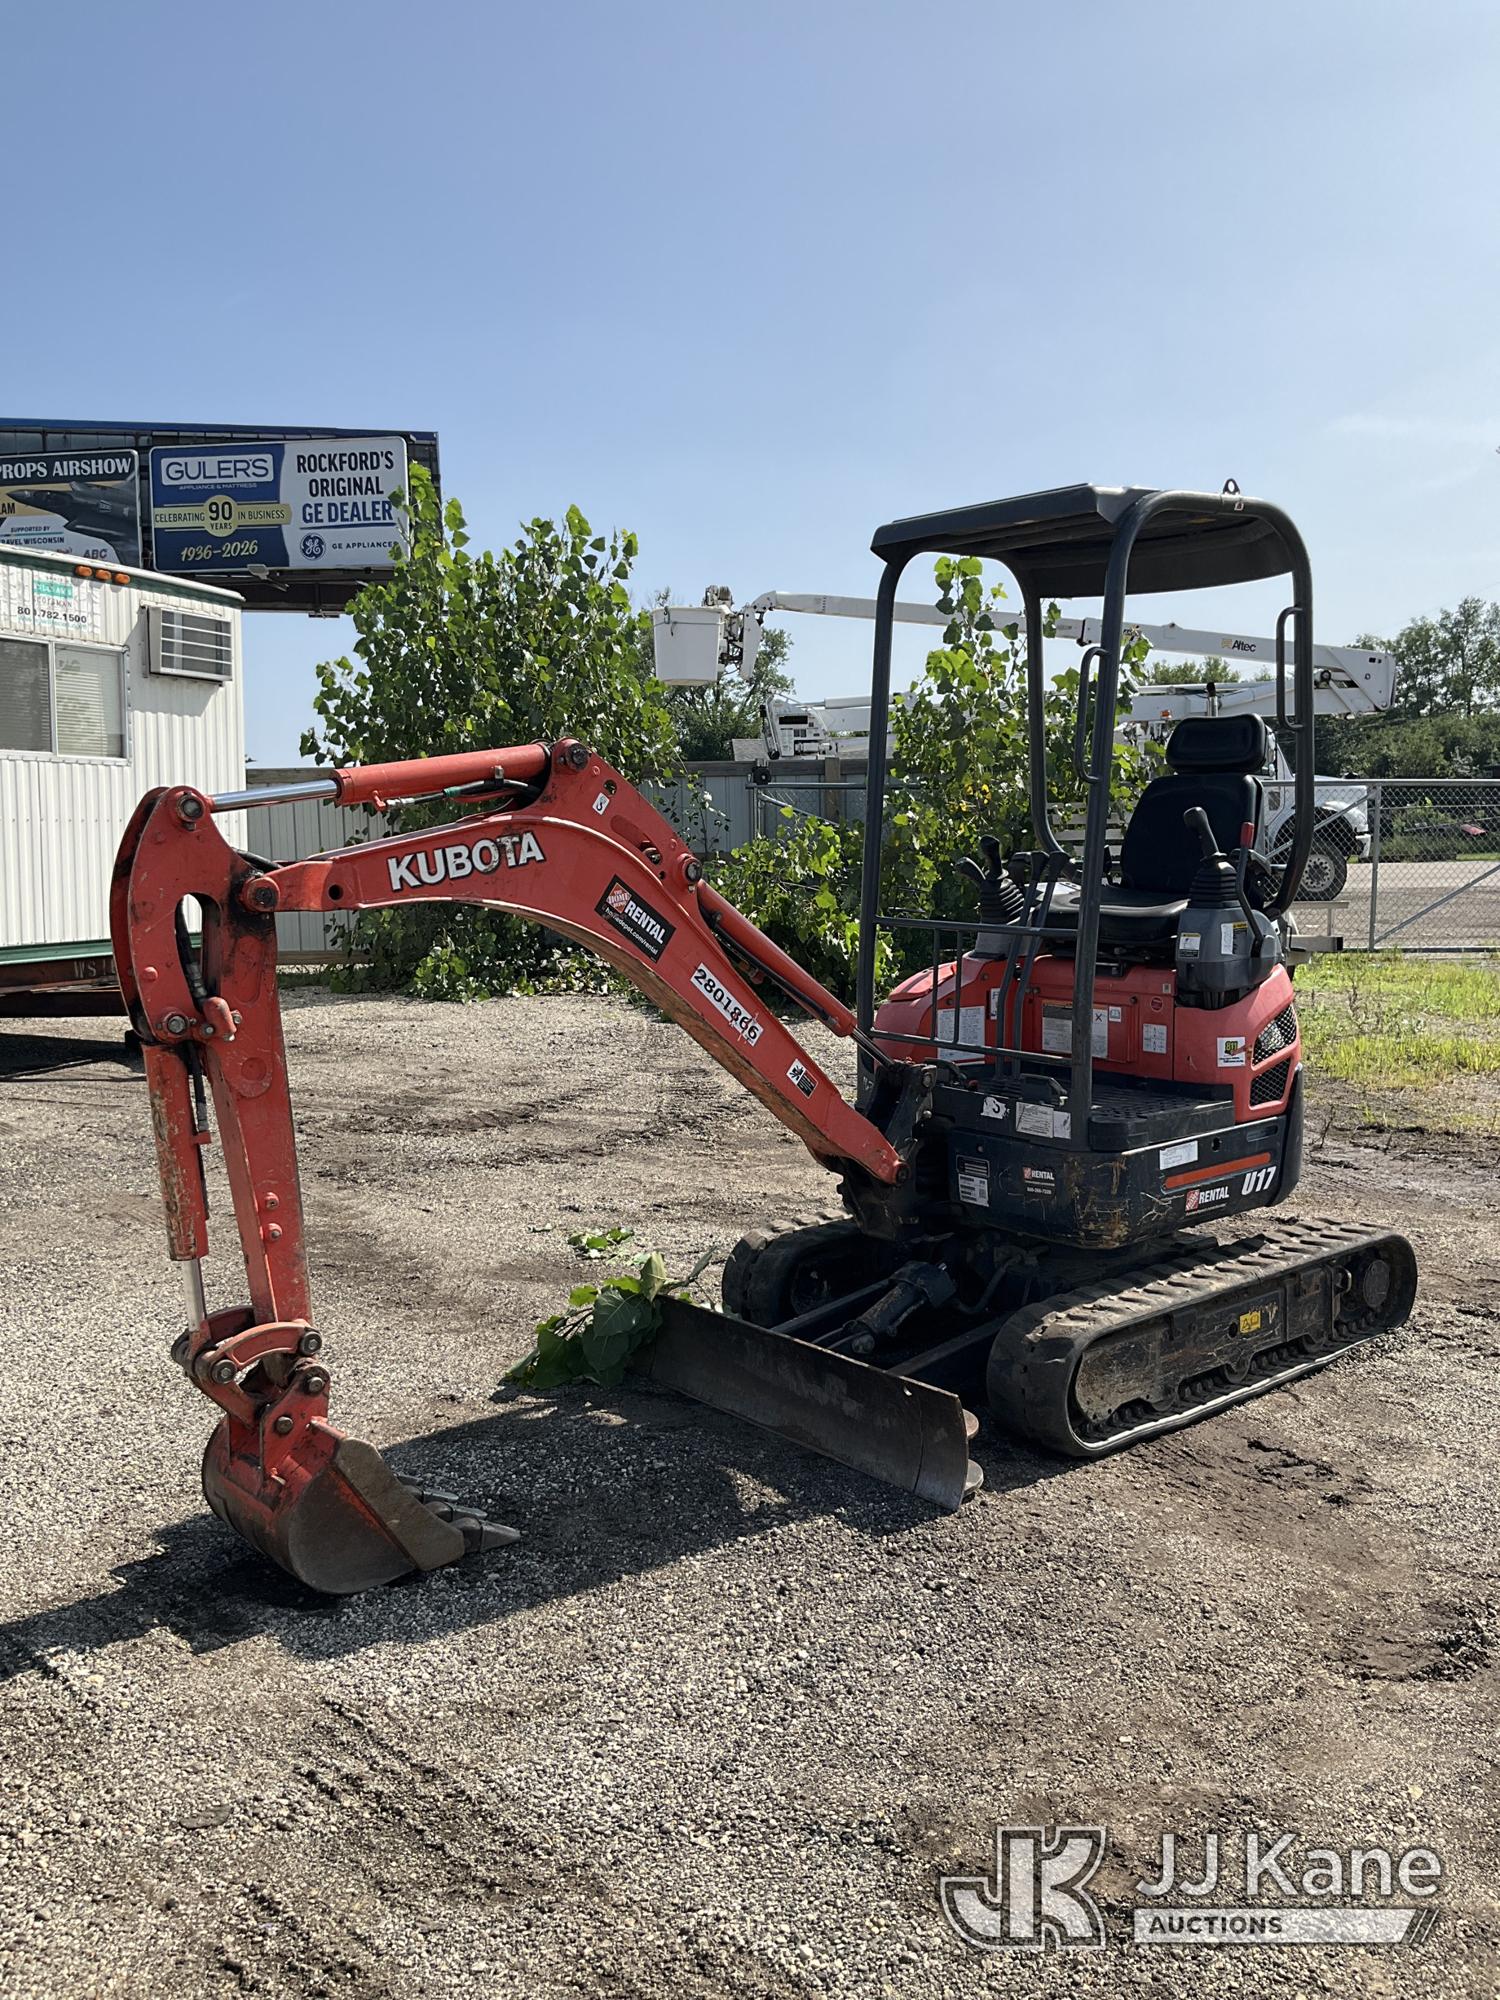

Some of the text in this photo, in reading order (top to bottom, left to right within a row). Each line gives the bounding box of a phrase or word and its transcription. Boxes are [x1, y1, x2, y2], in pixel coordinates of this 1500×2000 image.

[0, 458, 131, 480] ROPS AIRSHOW
[166, 458, 269, 480] GULER'S
[296, 450, 394, 474] ROCKFORD'S
[309, 476, 384, 498] ORIGINAL
[0, 502, 16, 515] AM
[154, 501, 285, 523] CELEBRATING 90 IN BUSINESS
[302, 501, 393, 524] GE DEALER
[210, 522, 233, 531] YEARS
[24, 536, 65, 545] WISCONSIN
[1231, 639, 1256, 652] Altec
[387, 832, 546, 892] KUBOTA
[624, 900, 666, 945] RENTAL
[694, 968, 760, 1041] 2801866
[1225, 1041, 1239, 1051] 811
[1031, 1170, 1055, 1181] RENTAL
[1241, 1165, 1277, 1196] U17
[1198, 1186, 1230, 1205] RENTAL
